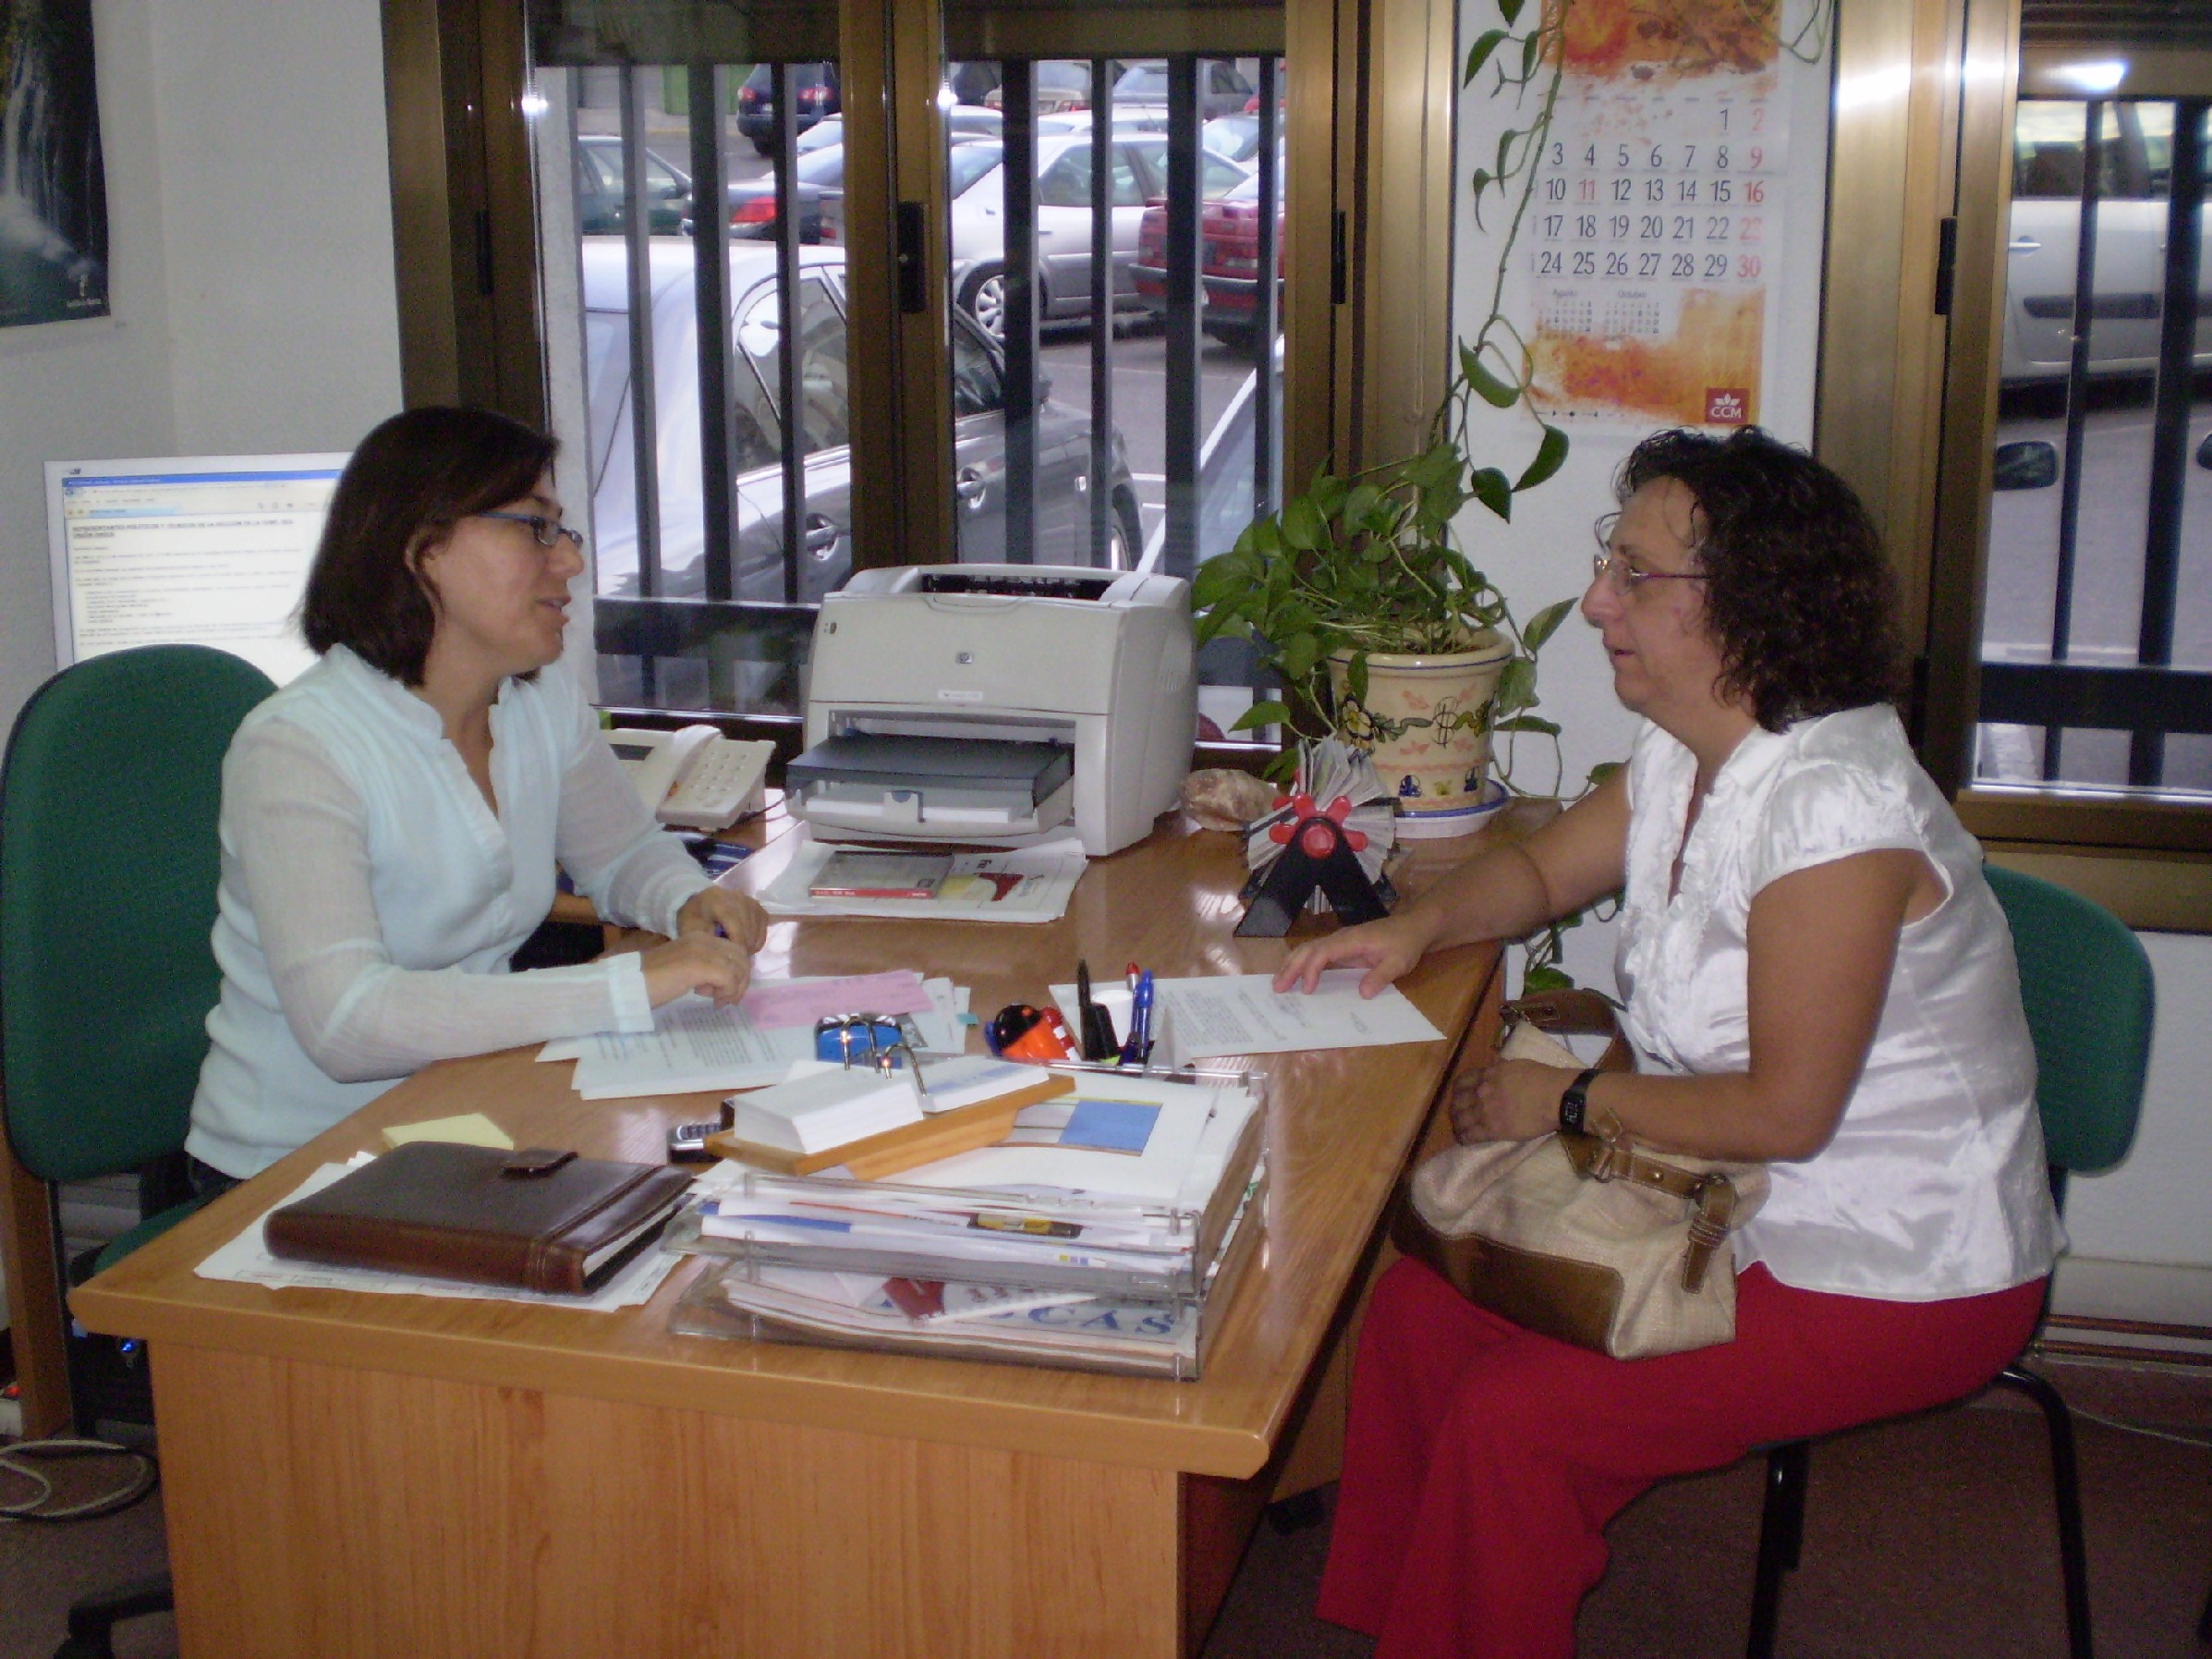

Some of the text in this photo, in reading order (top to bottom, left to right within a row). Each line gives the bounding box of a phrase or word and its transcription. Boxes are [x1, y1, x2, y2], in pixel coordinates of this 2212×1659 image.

[1720, 107, 1764, 132] 1 2
[1552, 142, 1762, 168] 3 4 5 6 7 8 9
[1546, 178, 1764, 202] 10 11 12 13 14 15 16
[1544, 214, 1563, 237] 17
[1576, 214, 1596, 238] 18
[1610, 215, 1629, 238] 19
[1640, 215, 1663, 238] 20
[1672, 216, 1694, 238] 21
[1707, 216, 1730, 239] 22
[1541, 251, 1761, 277] 24 25 26 27 28 29 30
[1711, 407, 1742, 418] CCM
[989, 1306, 1175, 1334] CAS
